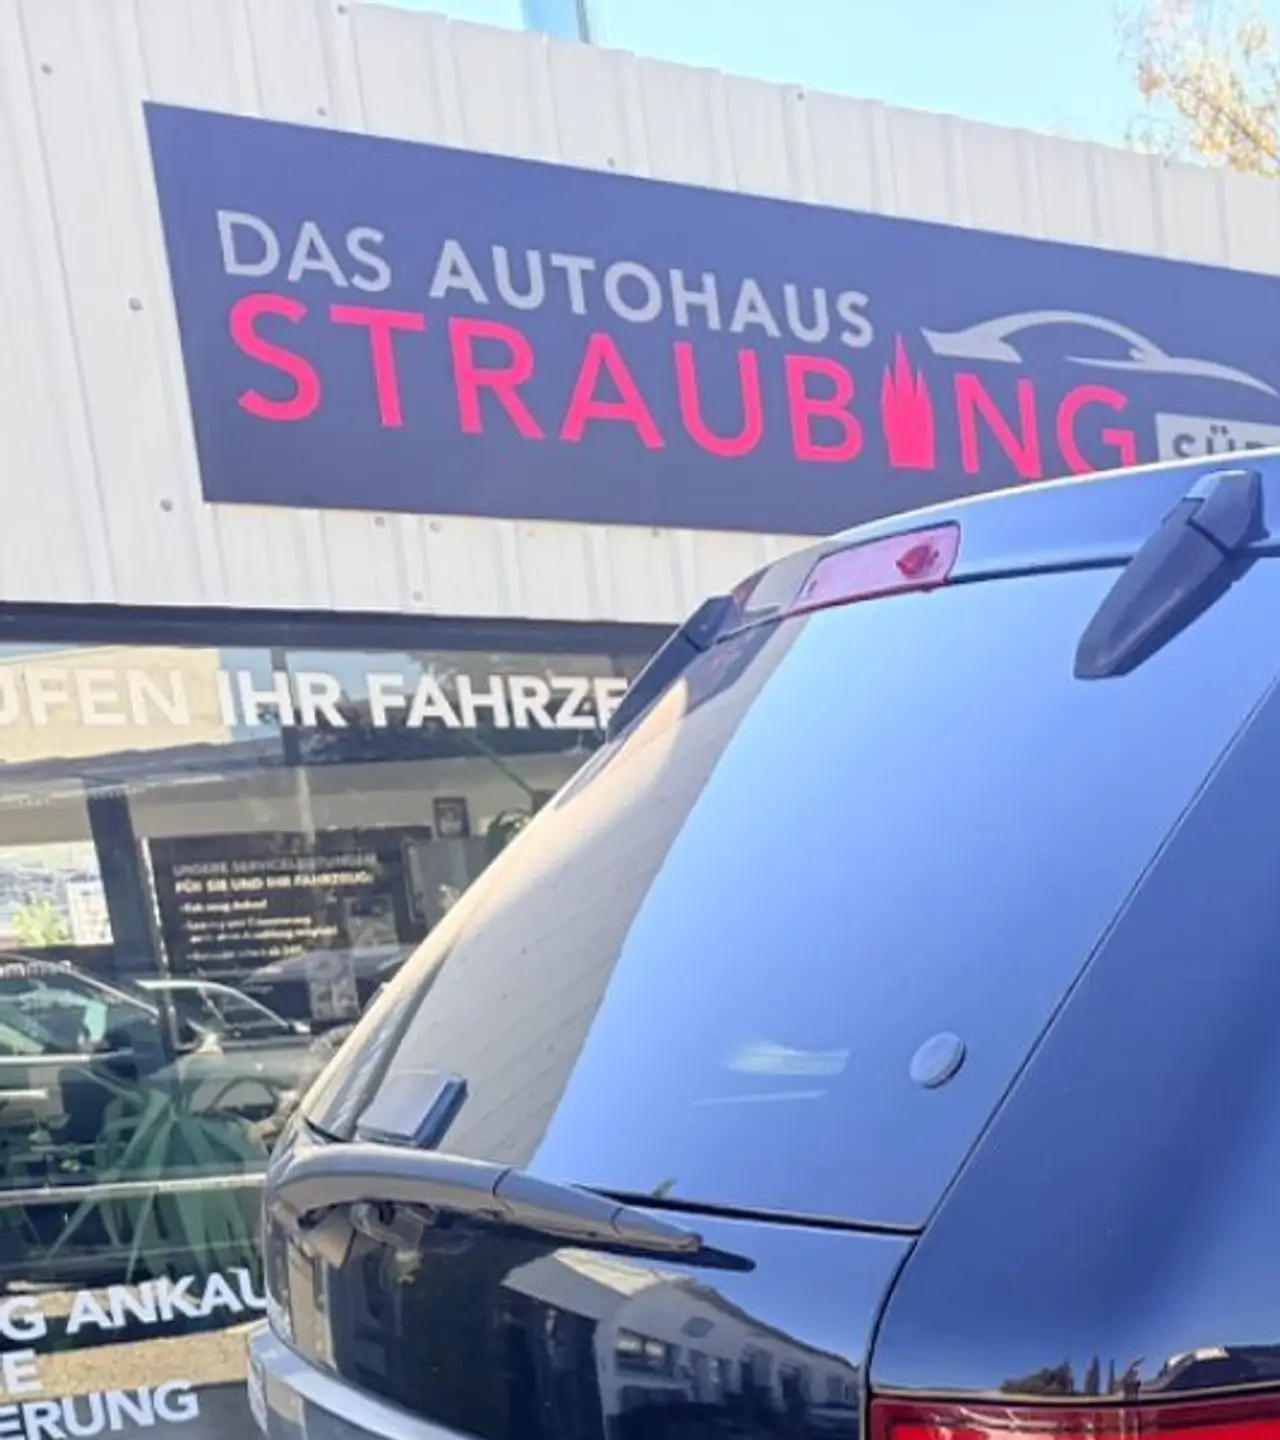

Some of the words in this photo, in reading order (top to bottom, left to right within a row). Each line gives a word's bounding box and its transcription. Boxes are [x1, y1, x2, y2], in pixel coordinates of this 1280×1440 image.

[216, 209, 393, 293] DAS
[428, 238, 874, 349] AUTOHAUS
[217, 668, 346, 728] IHR
